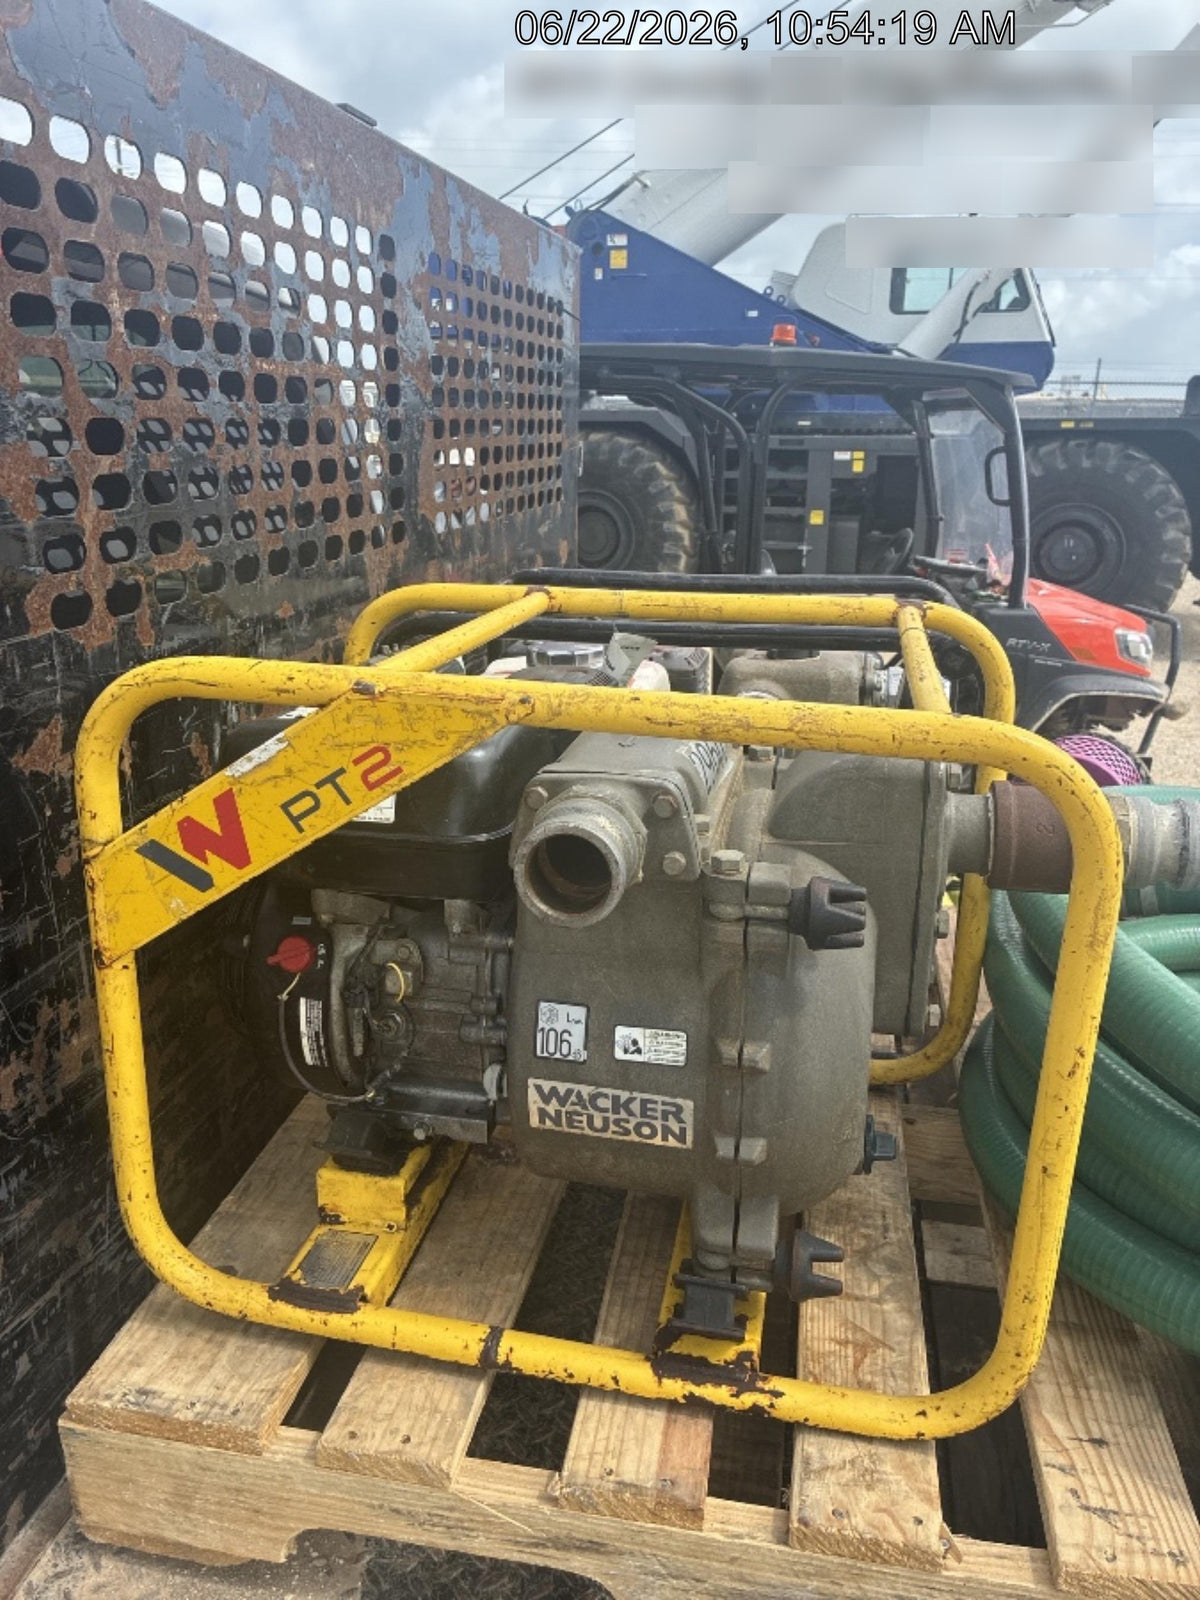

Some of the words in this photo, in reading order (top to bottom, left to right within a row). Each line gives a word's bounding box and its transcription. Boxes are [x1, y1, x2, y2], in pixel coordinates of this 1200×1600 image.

[537, 1027, 573, 1058] 106
[533, 1083, 687, 1124] WACKER
[537, 1107, 687, 1146] NEUSON
